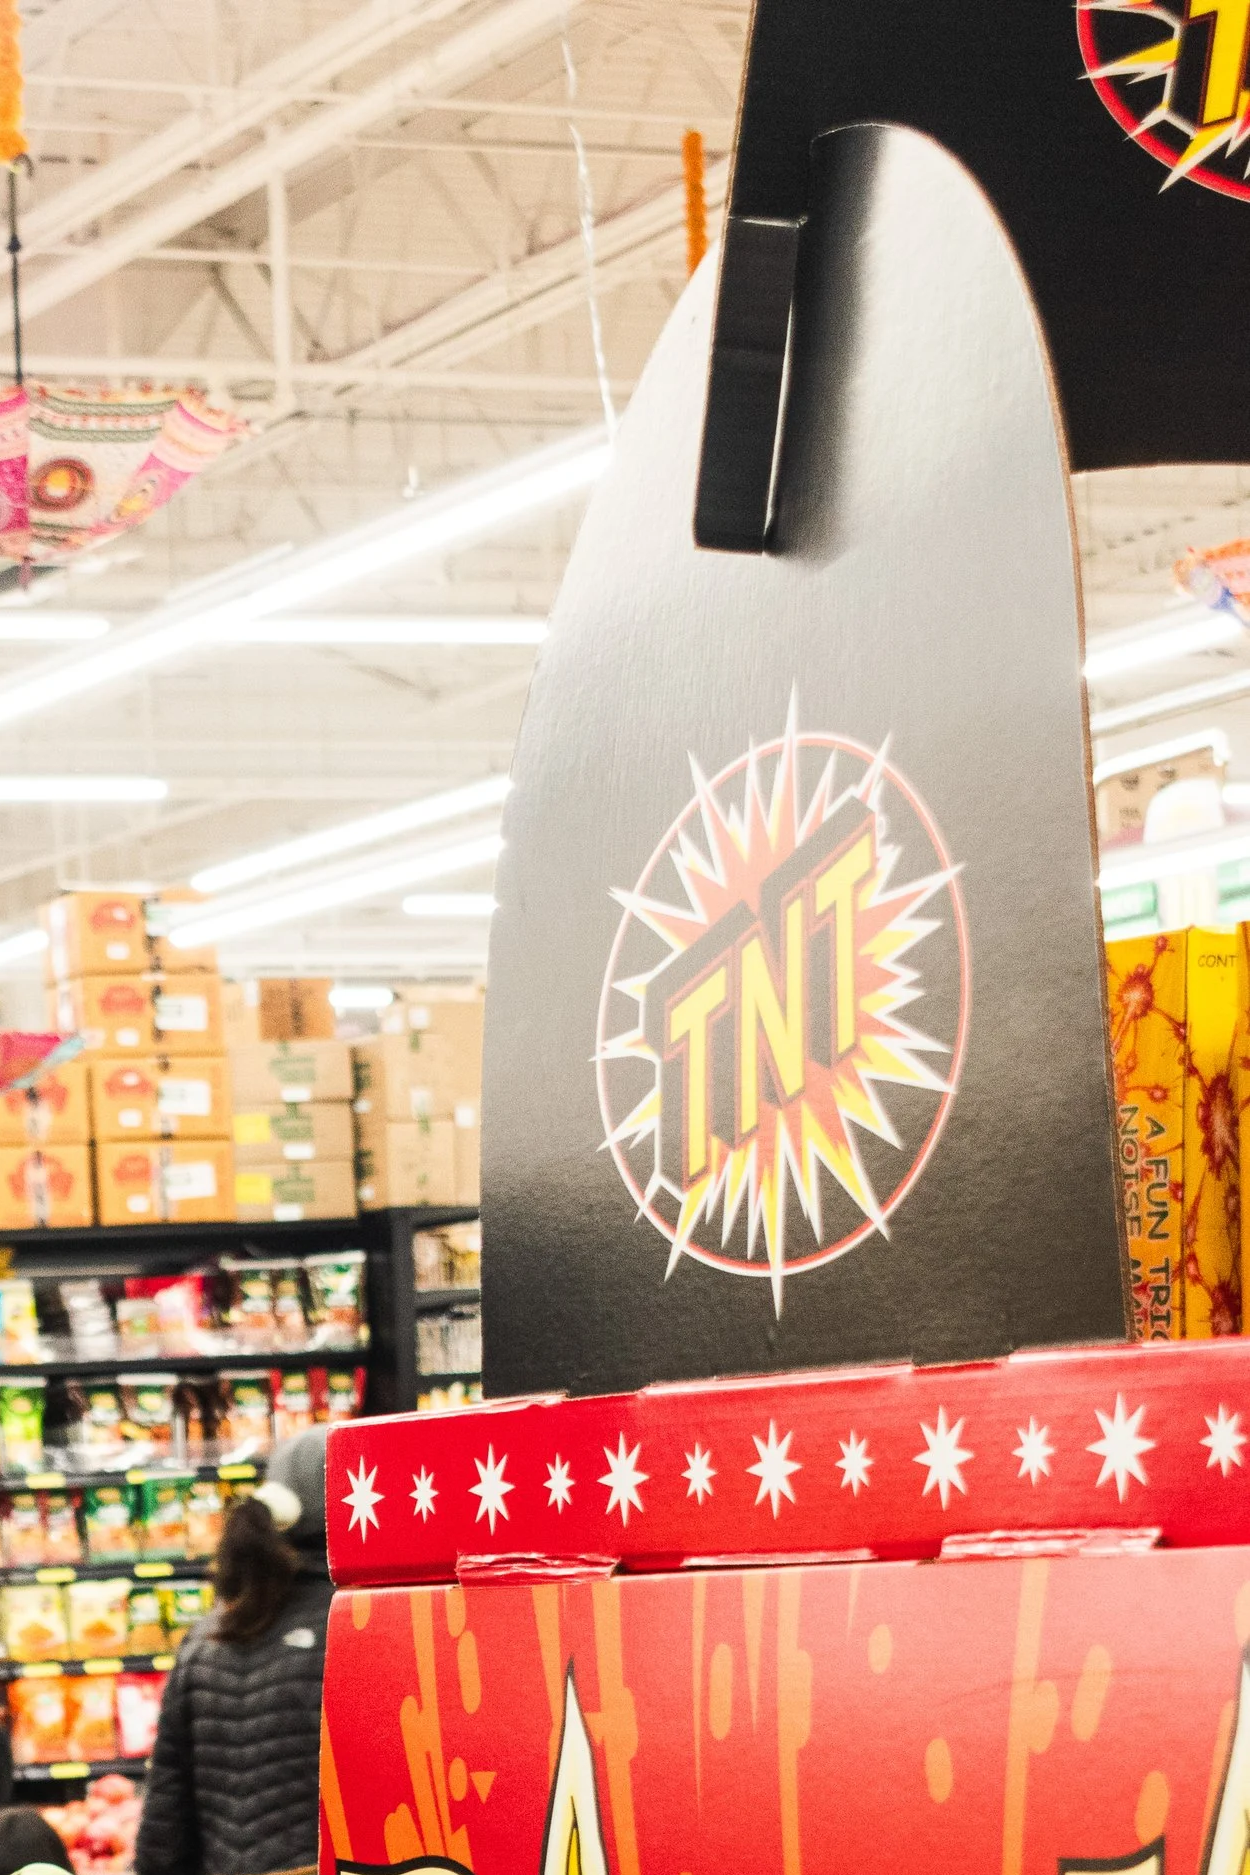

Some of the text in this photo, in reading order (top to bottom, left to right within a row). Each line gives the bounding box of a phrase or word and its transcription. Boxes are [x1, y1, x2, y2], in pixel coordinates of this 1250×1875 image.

[663, 818, 877, 1190] TNT
[1119, 1105, 1143, 1237] NOISE
[1145, 1115, 1166, 1140] A
[1146, 1157, 1171, 1241] FUN
